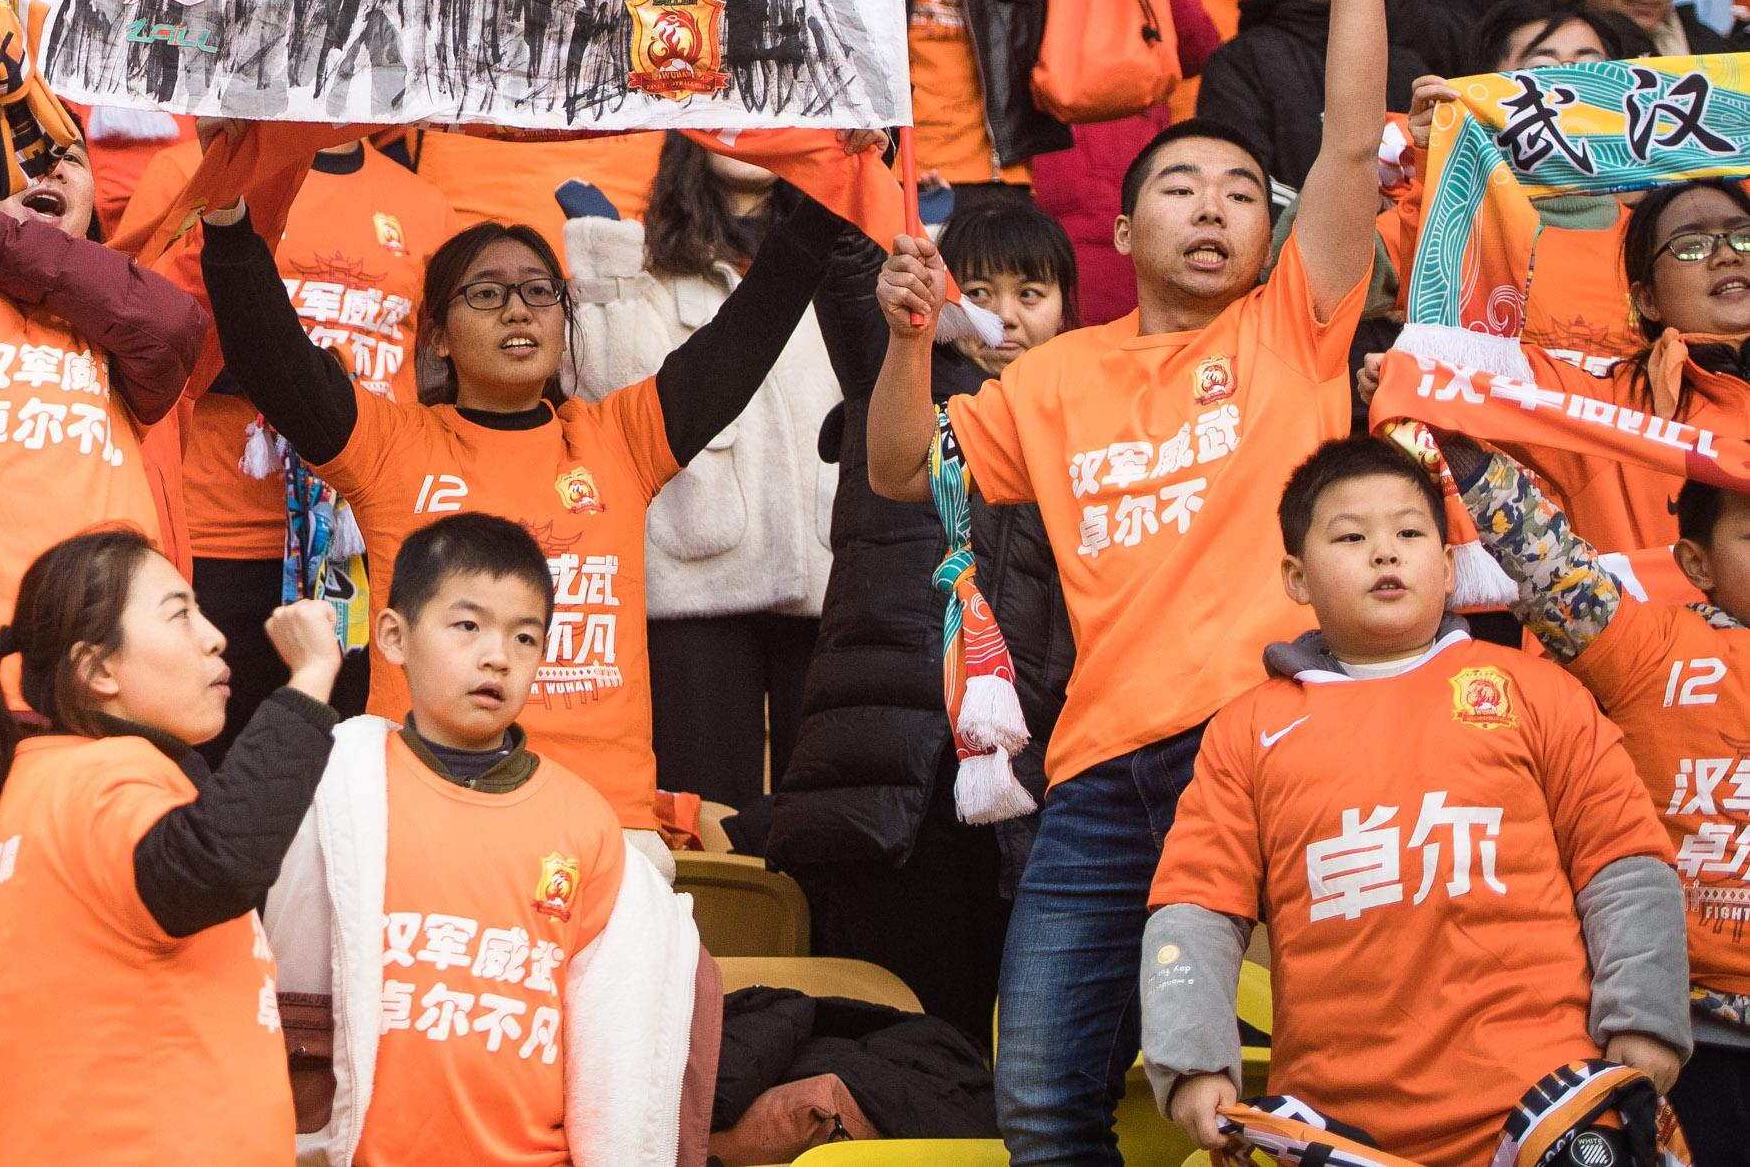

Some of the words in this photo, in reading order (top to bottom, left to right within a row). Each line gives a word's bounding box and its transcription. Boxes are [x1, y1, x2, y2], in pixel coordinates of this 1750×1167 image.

[1496, 68, 1740, 176] 武汉
[302, 325, 404, 381] 尔不凡
[1068, 403, 1242, 499] 汉军威武
[413, 474, 468, 514] 12
[1076, 476, 1208, 559] 卓尔不
[545, 611, 617, 664] 不凡
[545, 680, 594, 695] WUHAN
[1662, 657, 1728, 708] 12
[1304, 790, 1507, 924] 卓尔
[1675, 821, 1750, 882] 卓
[381, 978, 561, 1065] 卓尔不凡
[1578, 1137, 1603, 1145] WHITE
